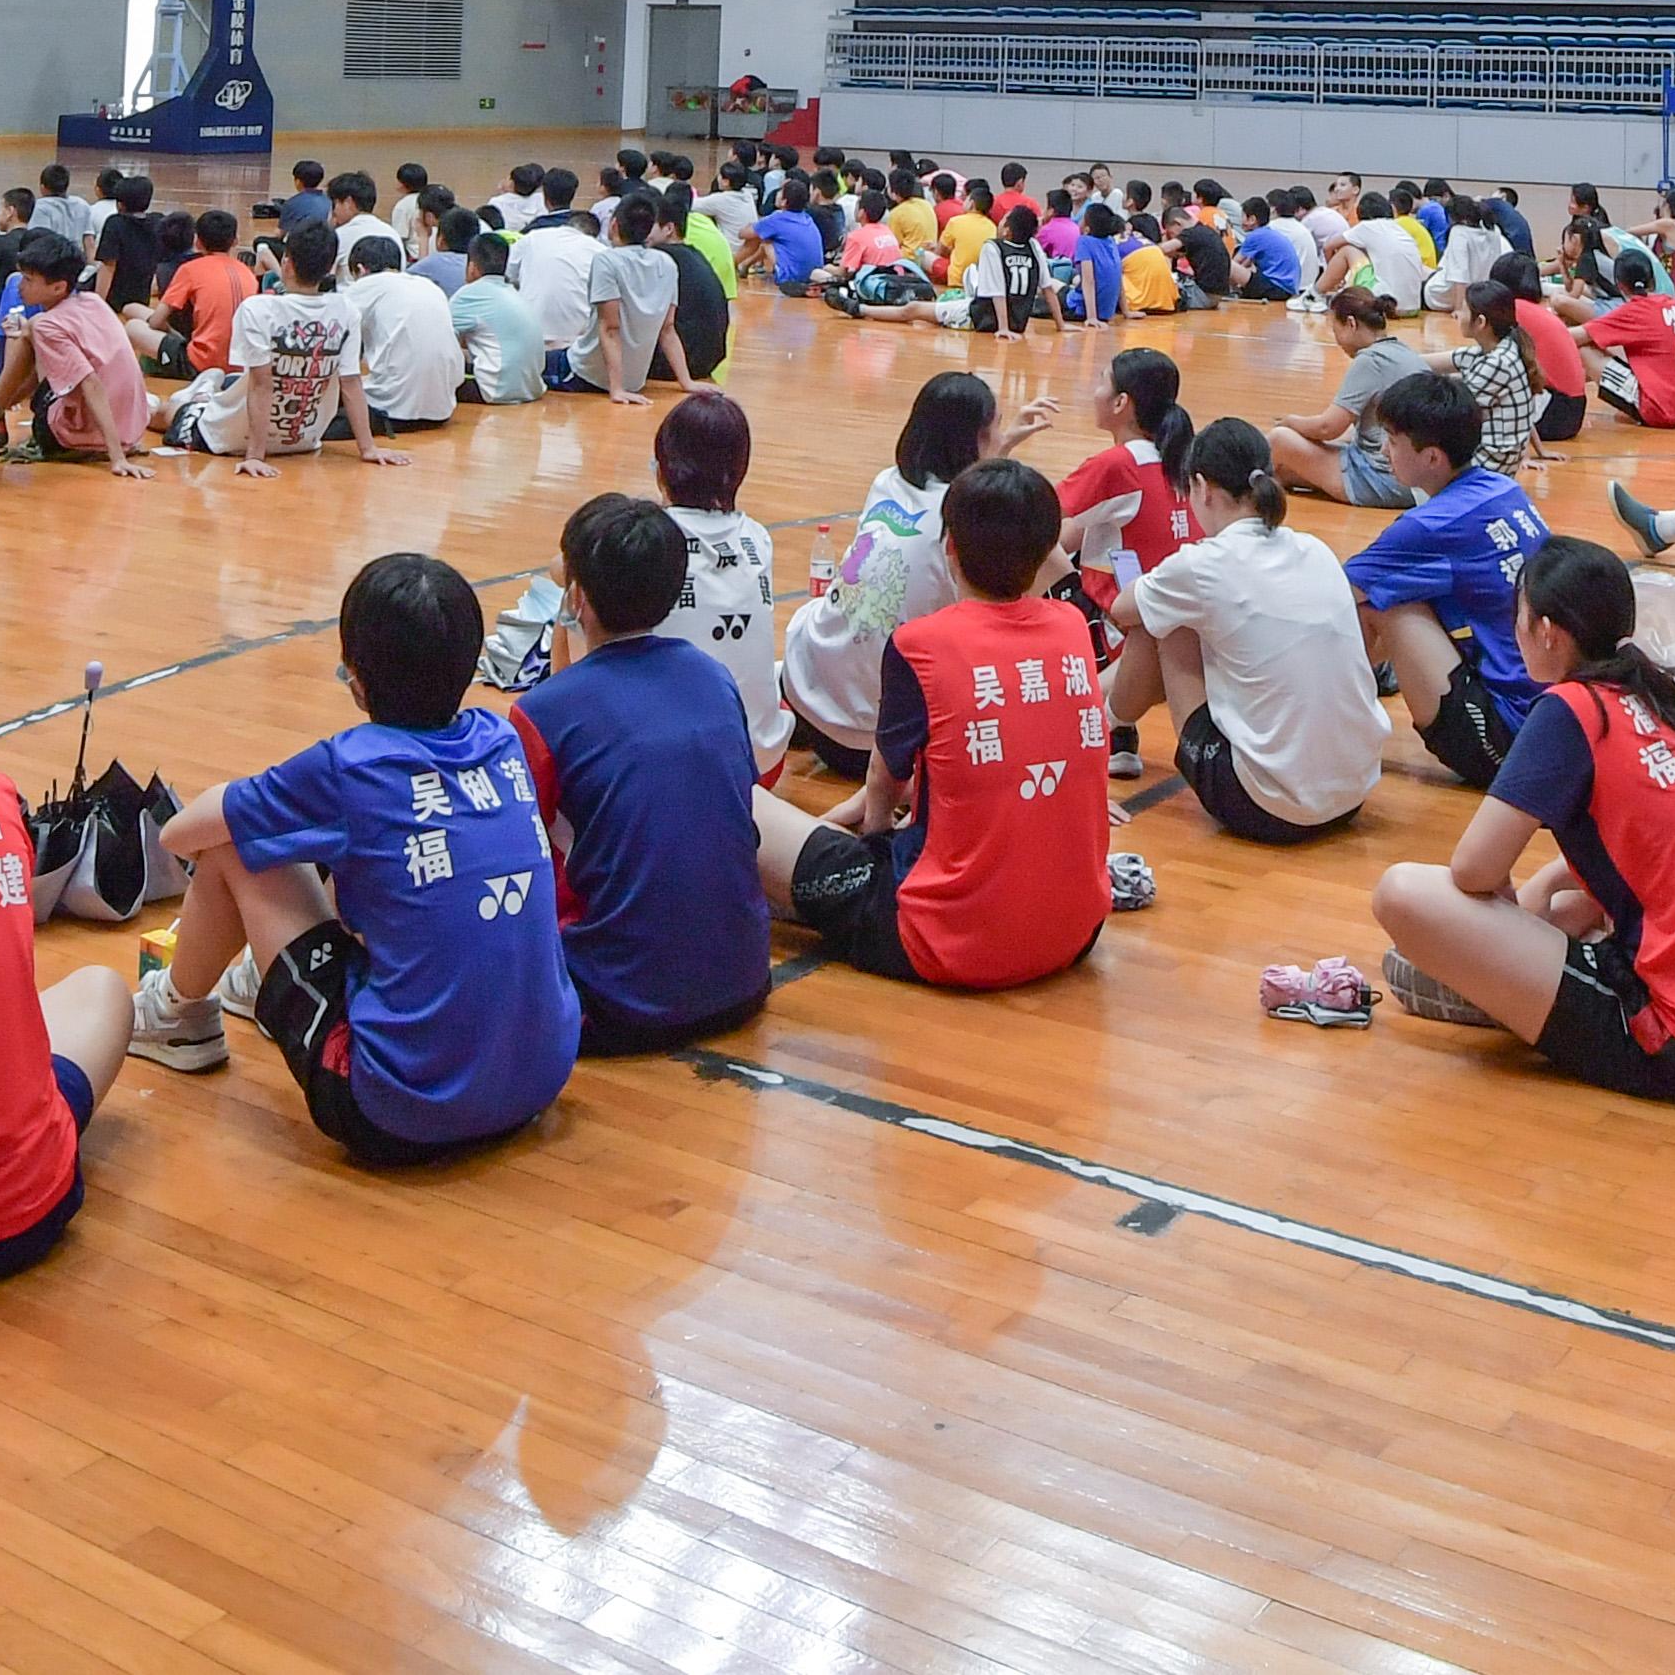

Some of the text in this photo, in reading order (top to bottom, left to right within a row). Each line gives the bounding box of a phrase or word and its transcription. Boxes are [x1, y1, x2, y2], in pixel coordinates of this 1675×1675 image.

[1009, 265, 1029, 296] 11
[971, 653, 1093, 711] 吴嘉淑
[964, 704, 1106, 766] 福建
